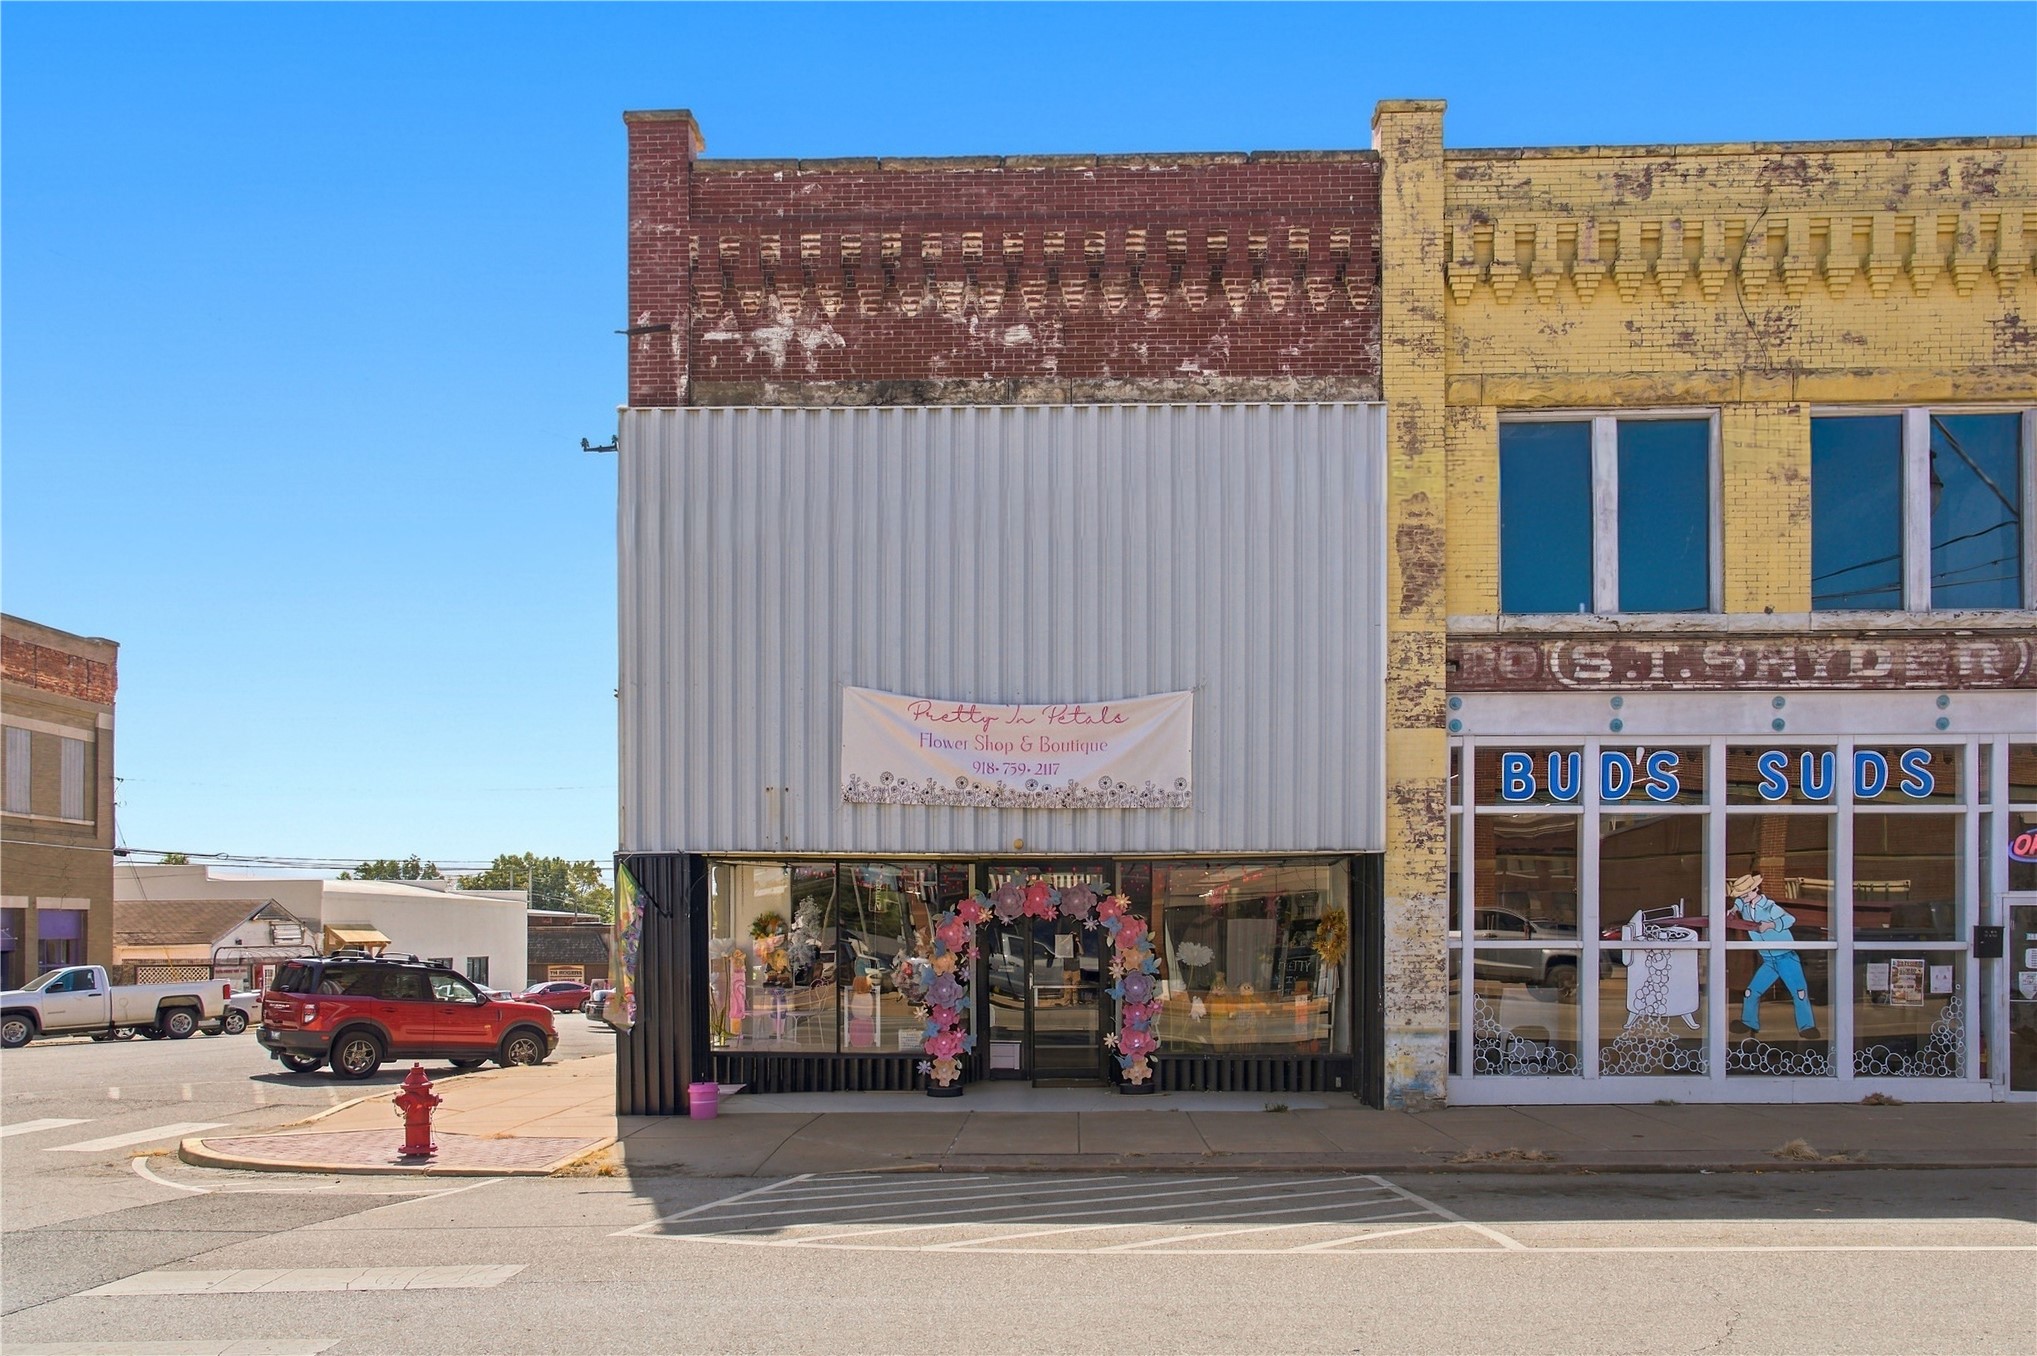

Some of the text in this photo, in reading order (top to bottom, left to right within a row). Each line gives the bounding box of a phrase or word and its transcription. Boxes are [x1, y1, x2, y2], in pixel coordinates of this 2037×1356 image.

[907, 700, 999, 732] Pretty
[1042, 704, 1129, 725] Petals
[920, 732, 1108, 755] Flower Shop & Boutique
[1501, 746, 1935, 802] BUD'S SUDS
